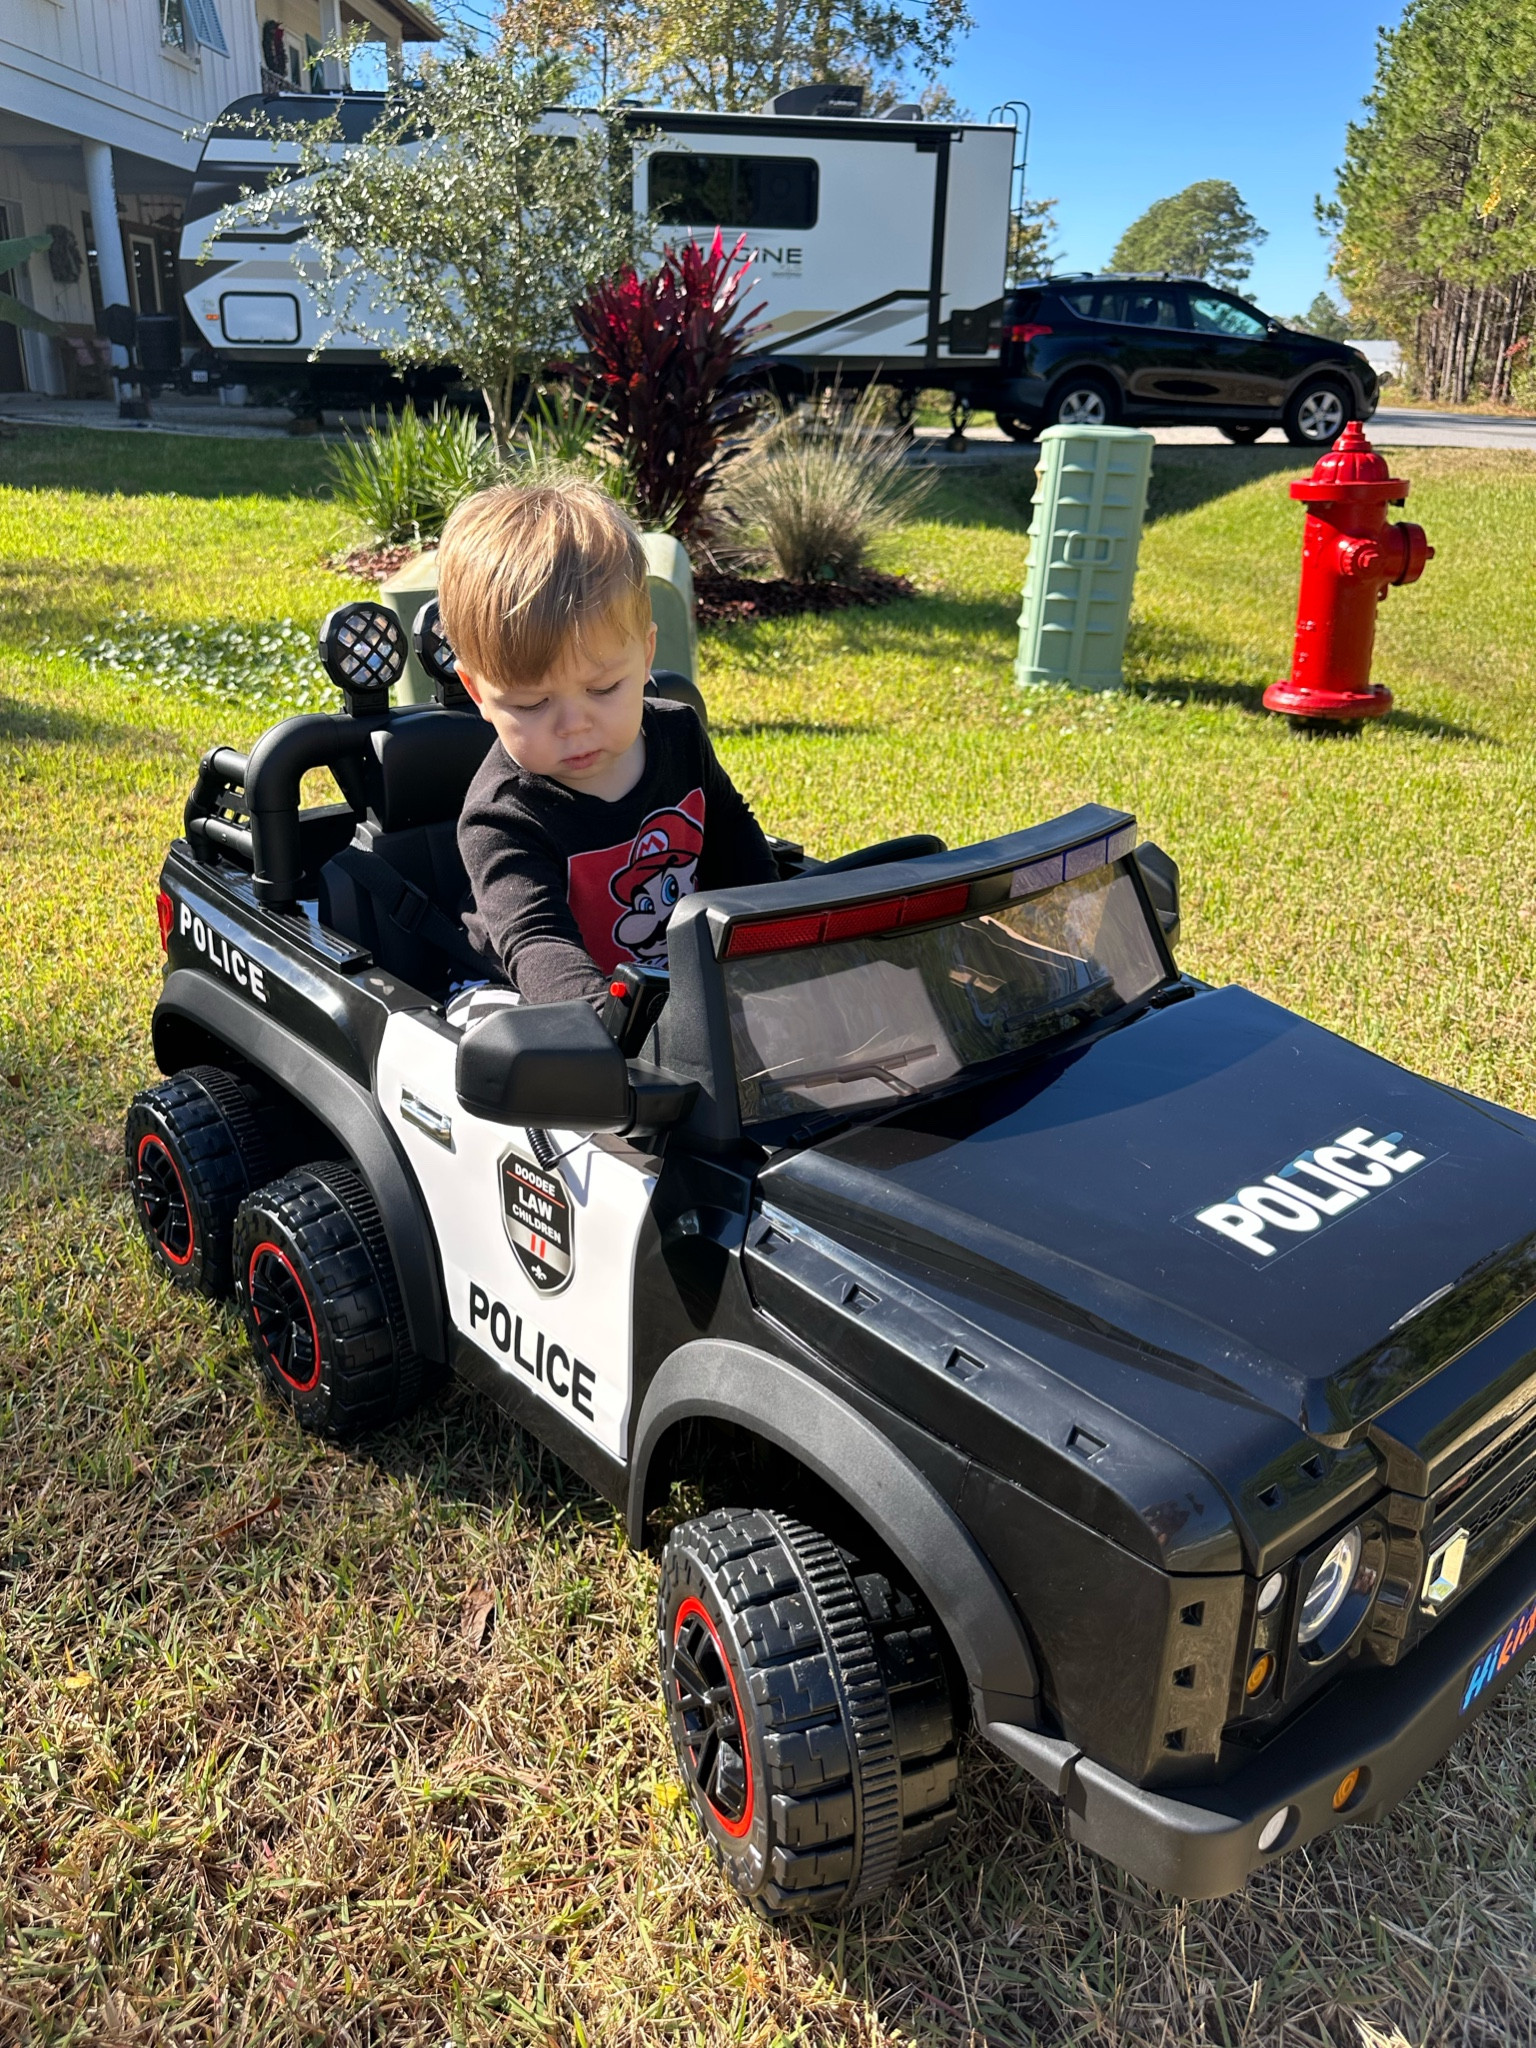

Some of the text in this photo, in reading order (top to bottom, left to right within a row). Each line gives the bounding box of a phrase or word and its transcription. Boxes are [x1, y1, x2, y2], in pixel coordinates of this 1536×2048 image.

[638, 834, 665, 857] M
[180, 902, 266, 1003] POLICE
[515, 1162, 556, 1198] DOODEE
[1195, 1126, 1426, 1257] POLICE
[512, 1203, 562, 1245] CHILDREN
[518, 1186, 553, 1222] LAW
[469, 1281, 596, 1422] POLICE
